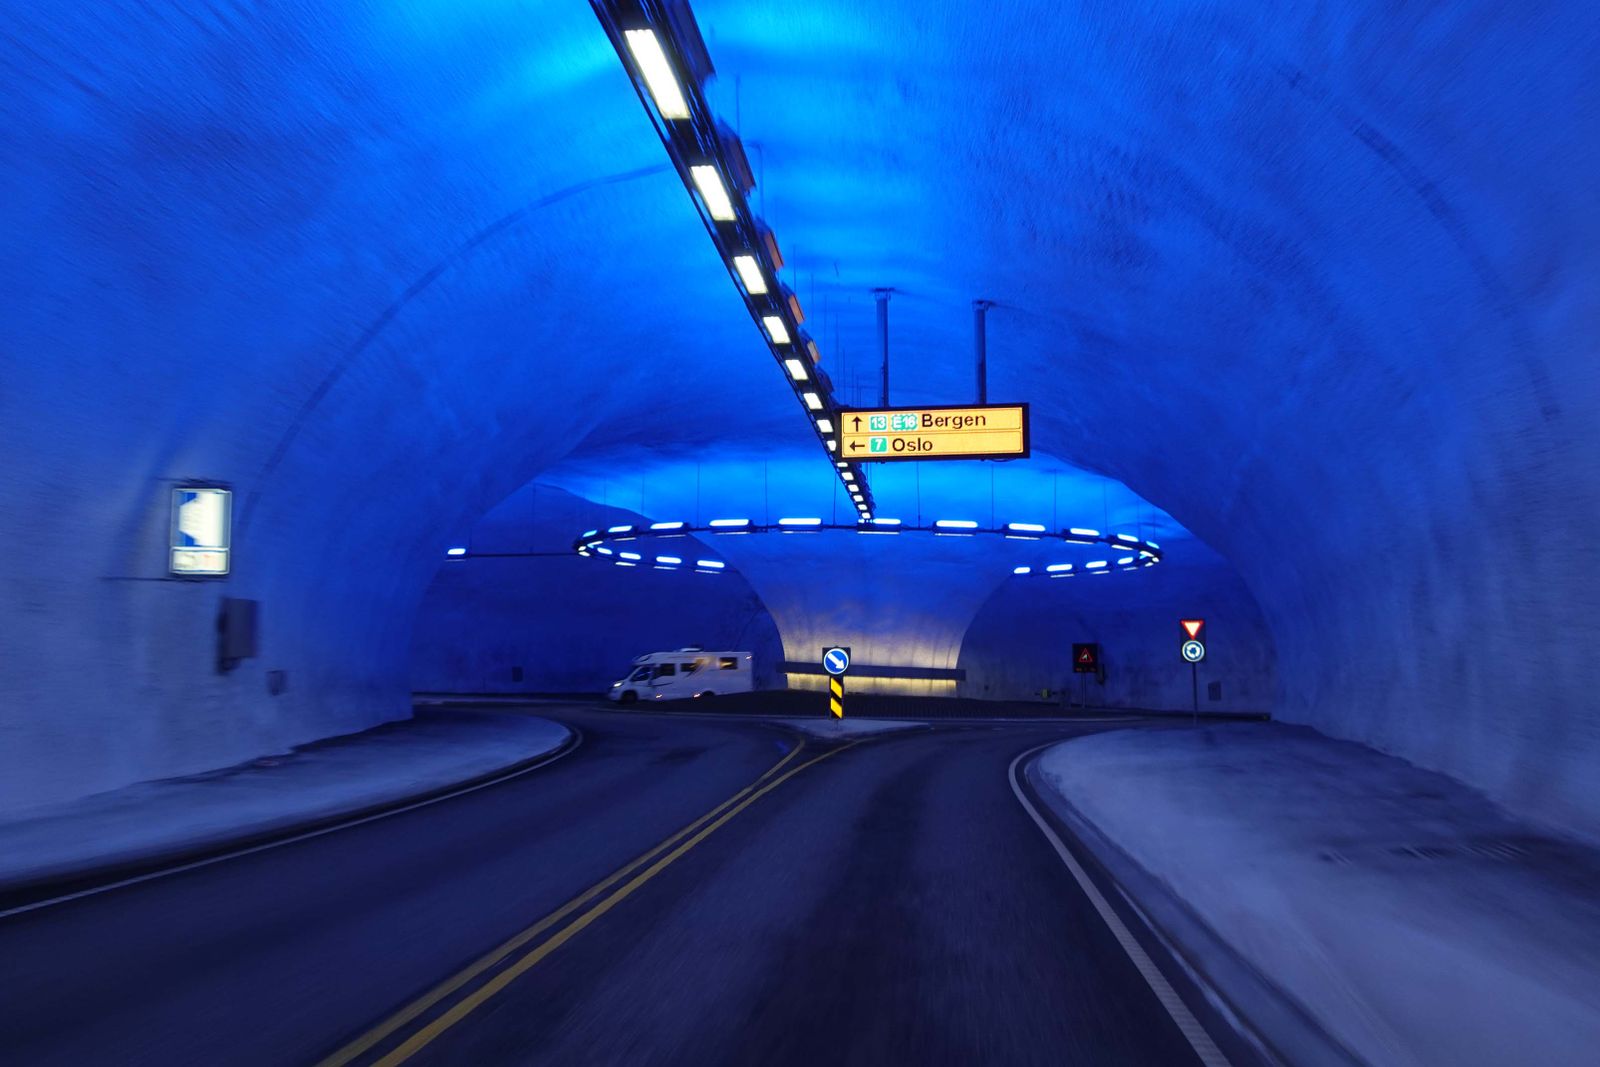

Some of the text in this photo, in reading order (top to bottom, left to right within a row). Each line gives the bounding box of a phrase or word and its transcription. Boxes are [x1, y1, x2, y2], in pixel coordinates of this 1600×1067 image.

[871, 413, 986, 429] 13 E16 Bergen
[875, 438, 933, 451] 7 Oslo
